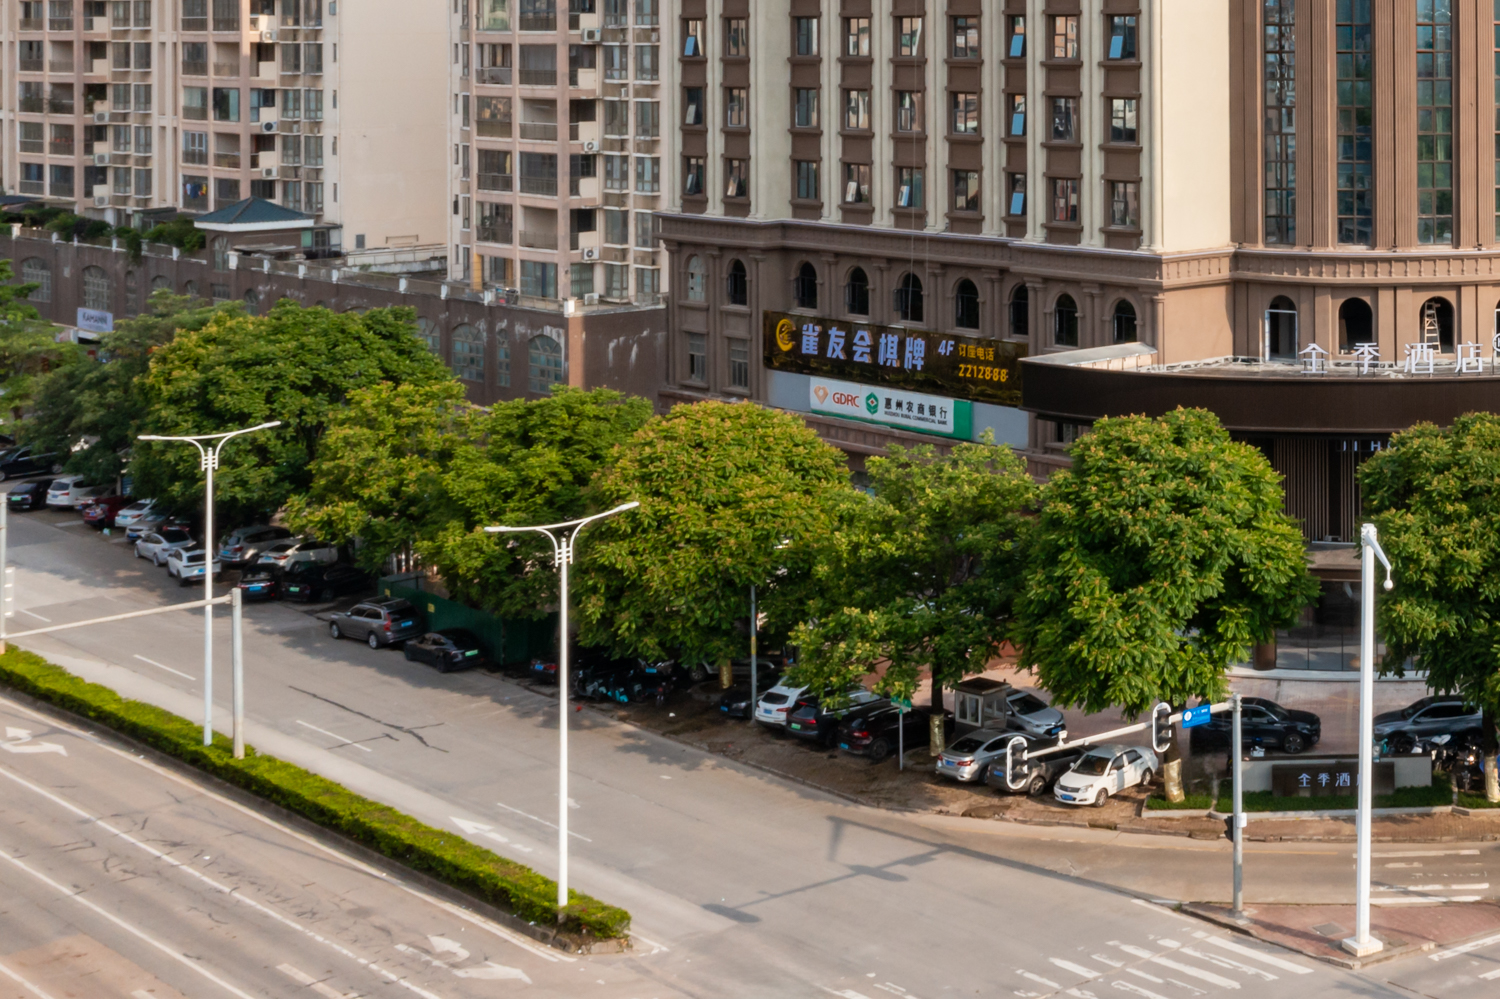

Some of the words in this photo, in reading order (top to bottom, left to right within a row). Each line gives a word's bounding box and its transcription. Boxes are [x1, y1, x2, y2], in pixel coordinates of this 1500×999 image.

[801, 323, 926, 371] 雀友会棋牌
[938, 340, 955, 356] 4F
[958, 343, 995, 361] 订座电话
[1298, 341, 1483, 374] 全季酒店
[958, 364, 1008, 382] 2212888
[832, 391, 860, 408] GDRC
[884, 397, 948, 419] 惠州农商银行
